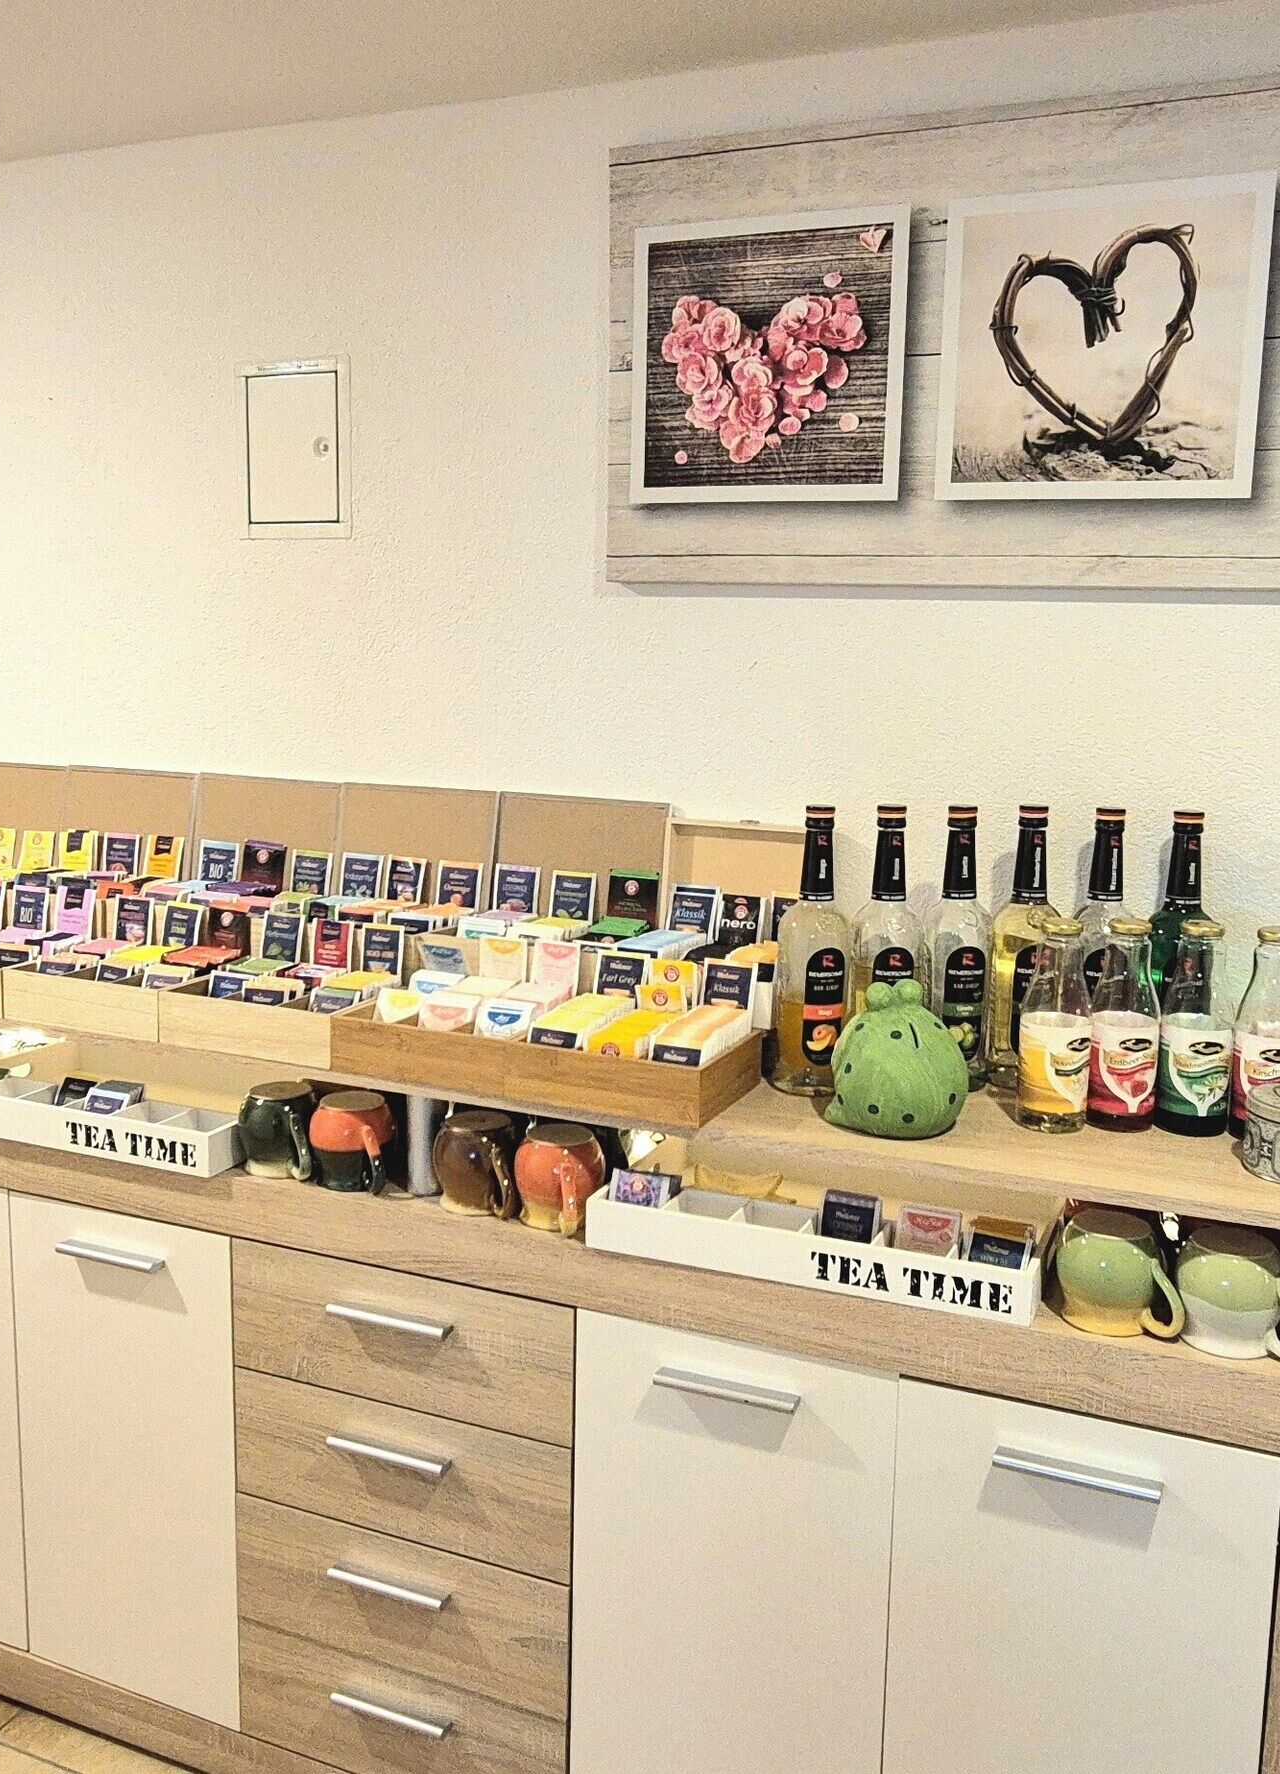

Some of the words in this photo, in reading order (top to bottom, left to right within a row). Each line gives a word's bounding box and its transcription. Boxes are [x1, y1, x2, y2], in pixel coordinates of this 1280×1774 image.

[208, 863, 223, 879] BIO
[19, 906, 33, 923] BIO
[675, 907, 707, 920] Klassik
[721, 918, 756, 930] nero
[712, 982, 740, 994] Klassik
[65, 1121, 118, 1153] TEA
[125, 1132, 197, 1168] TIME
[810, 1251, 890, 1292] TEA
[902, 1267, 1013, 1314] TIME
